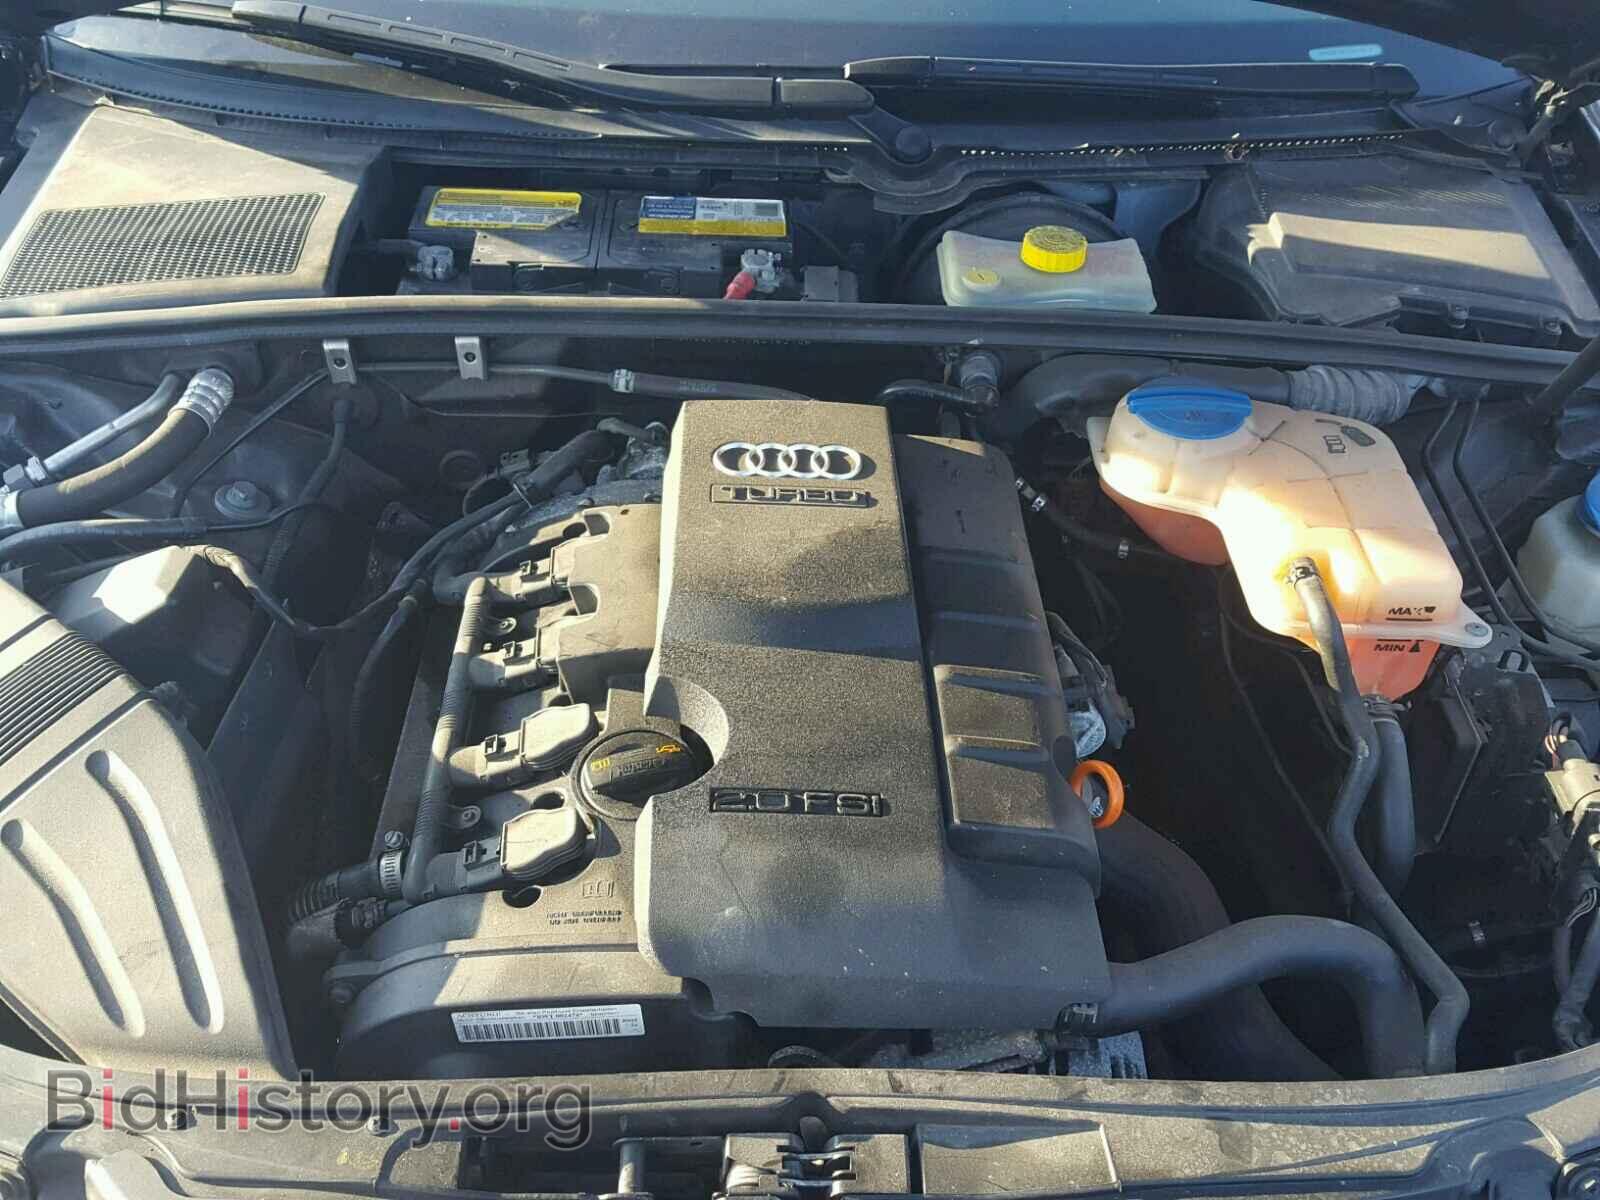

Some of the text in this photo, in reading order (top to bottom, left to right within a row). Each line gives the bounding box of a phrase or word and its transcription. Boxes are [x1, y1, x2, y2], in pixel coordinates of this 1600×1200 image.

[1374, 643, 1406, 652] MIN
[713, 790, 883, 815] 2.0 FSI
